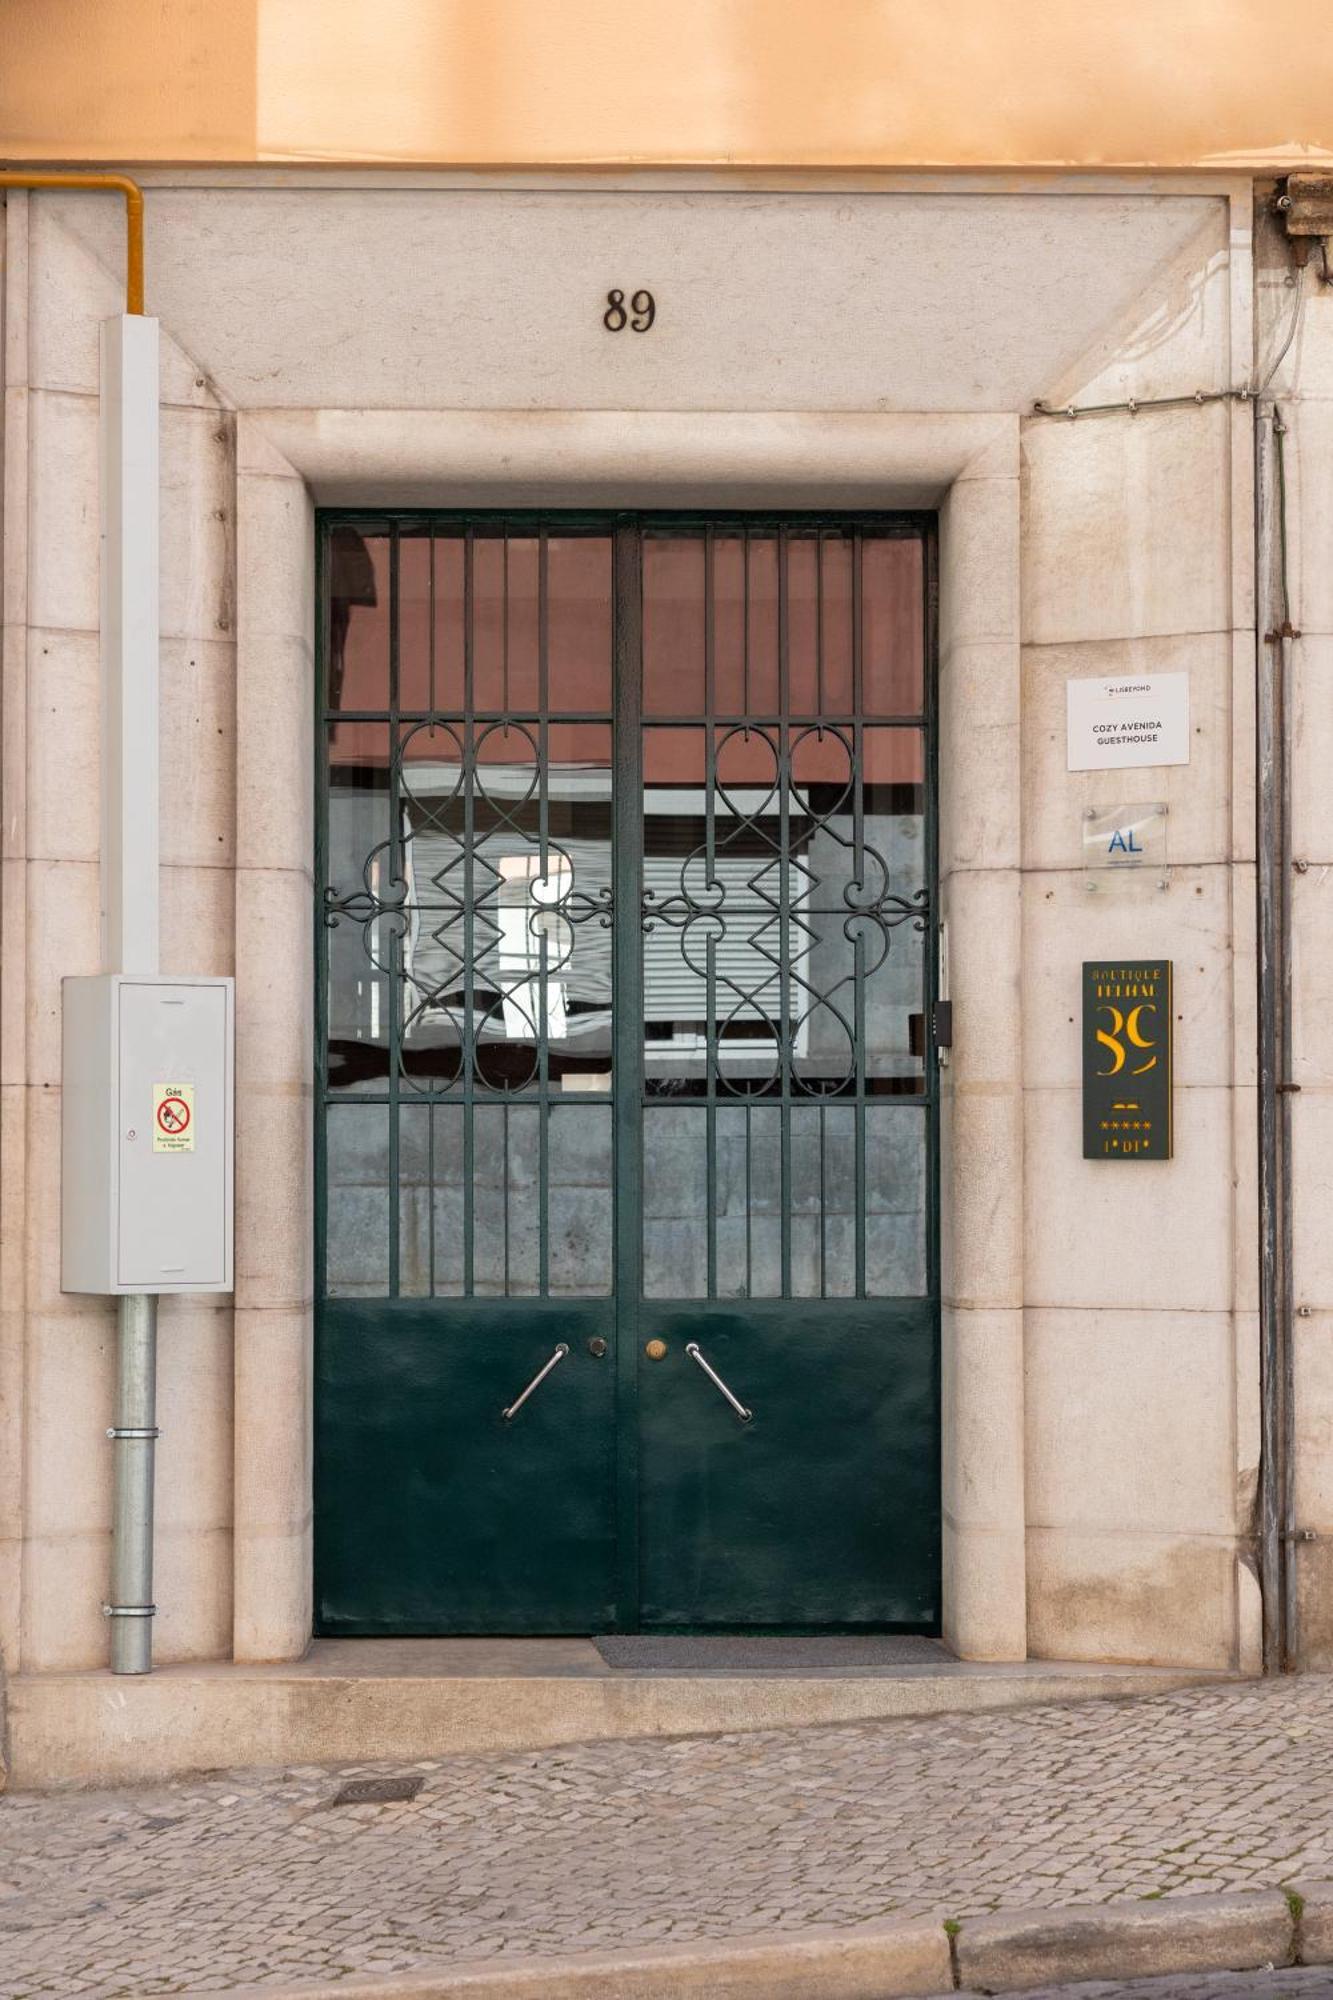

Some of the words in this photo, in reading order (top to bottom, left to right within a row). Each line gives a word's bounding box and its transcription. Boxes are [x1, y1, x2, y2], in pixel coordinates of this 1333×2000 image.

[604, 289, 656, 333] 89
[1092, 724, 1118, 733] COZY
[1121, 721, 1162, 731] AVENIDA
[1097, 734, 1158, 745] GUESTHOUSE
[1108, 830, 1142, 853] AL
[1091, 968, 1161, 982] BOUTIQUE
